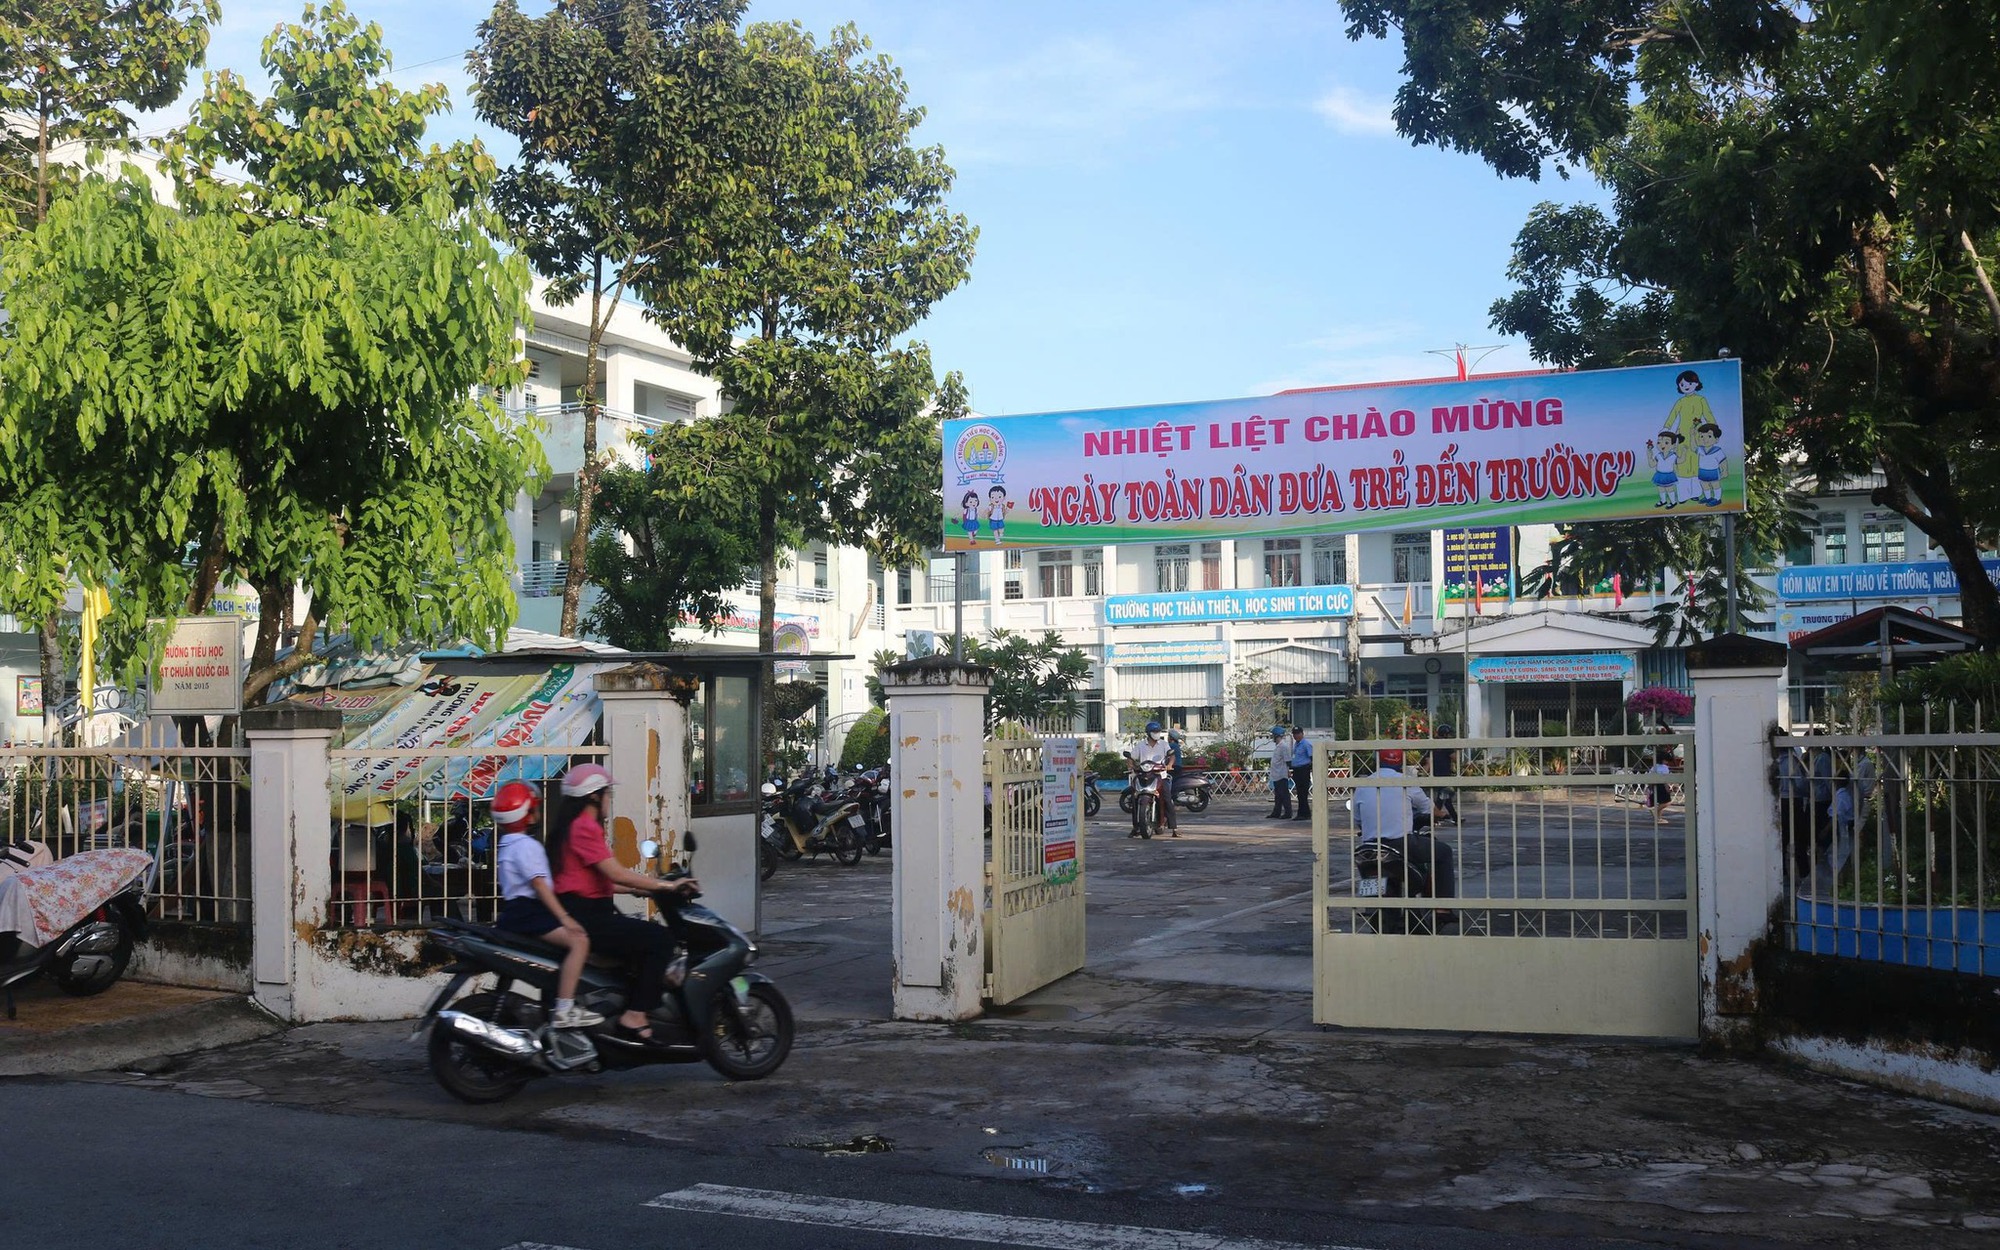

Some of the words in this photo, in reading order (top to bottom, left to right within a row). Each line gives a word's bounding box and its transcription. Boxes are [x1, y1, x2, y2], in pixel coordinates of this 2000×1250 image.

[1083, 421, 1196, 458] NHIỆT
[1209, 415, 1290, 452] LIỆT
[1304, 406, 1416, 442] CHÀO
[1432, 398, 1563, 434] MỪNG
[1124, 468, 1203, 523] TOÀN
[1209, 463, 1273, 519] DÂN
[1278, 463, 1344, 515] ĐƯA
[1350, 449, 1410, 511] TRẺ
[1415, 443, 1481, 508] ĐẾN
[1782, 573, 1803, 594] HÔM
[1805, 576, 1822, 593] NAY
[1825, 576, 1839, 592] EM
[1841, 572, 1854, 595] TỰ
[1856, 570, 1875, 591] HÀO
[1877, 566, 1889, 591] VỀ
[1891, 568, 1931, 592] TRƯỜNG,
[1933, 566, 1957, 588] NGÀY
[1109, 600, 1149, 619] TRƯỜNG
[1152, 602, 1174, 620] HỌC
[1176, 597, 1205, 616] THÂN
[1207, 595, 1243, 617] THIỆN,
[1245, 597, 1268, 616] HỌC
[1270, 597, 1296, 613] SINH
[1298, 592, 1324, 611] TÍCH
[1326, 592, 1349, 613] CỰC
[190, 640, 207, 658] TIỂU
[208, 646, 224, 661] HỌC
[170, 661, 194, 678] CHUẨN
[195, 661, 216, 677] QUỐC
[217, 665, 230, 677] GIA
[175, 681, 192, 690] NĂM
[193, 682, 210, 690] 2015
[496, 701, 554, 748] TUYỂN
